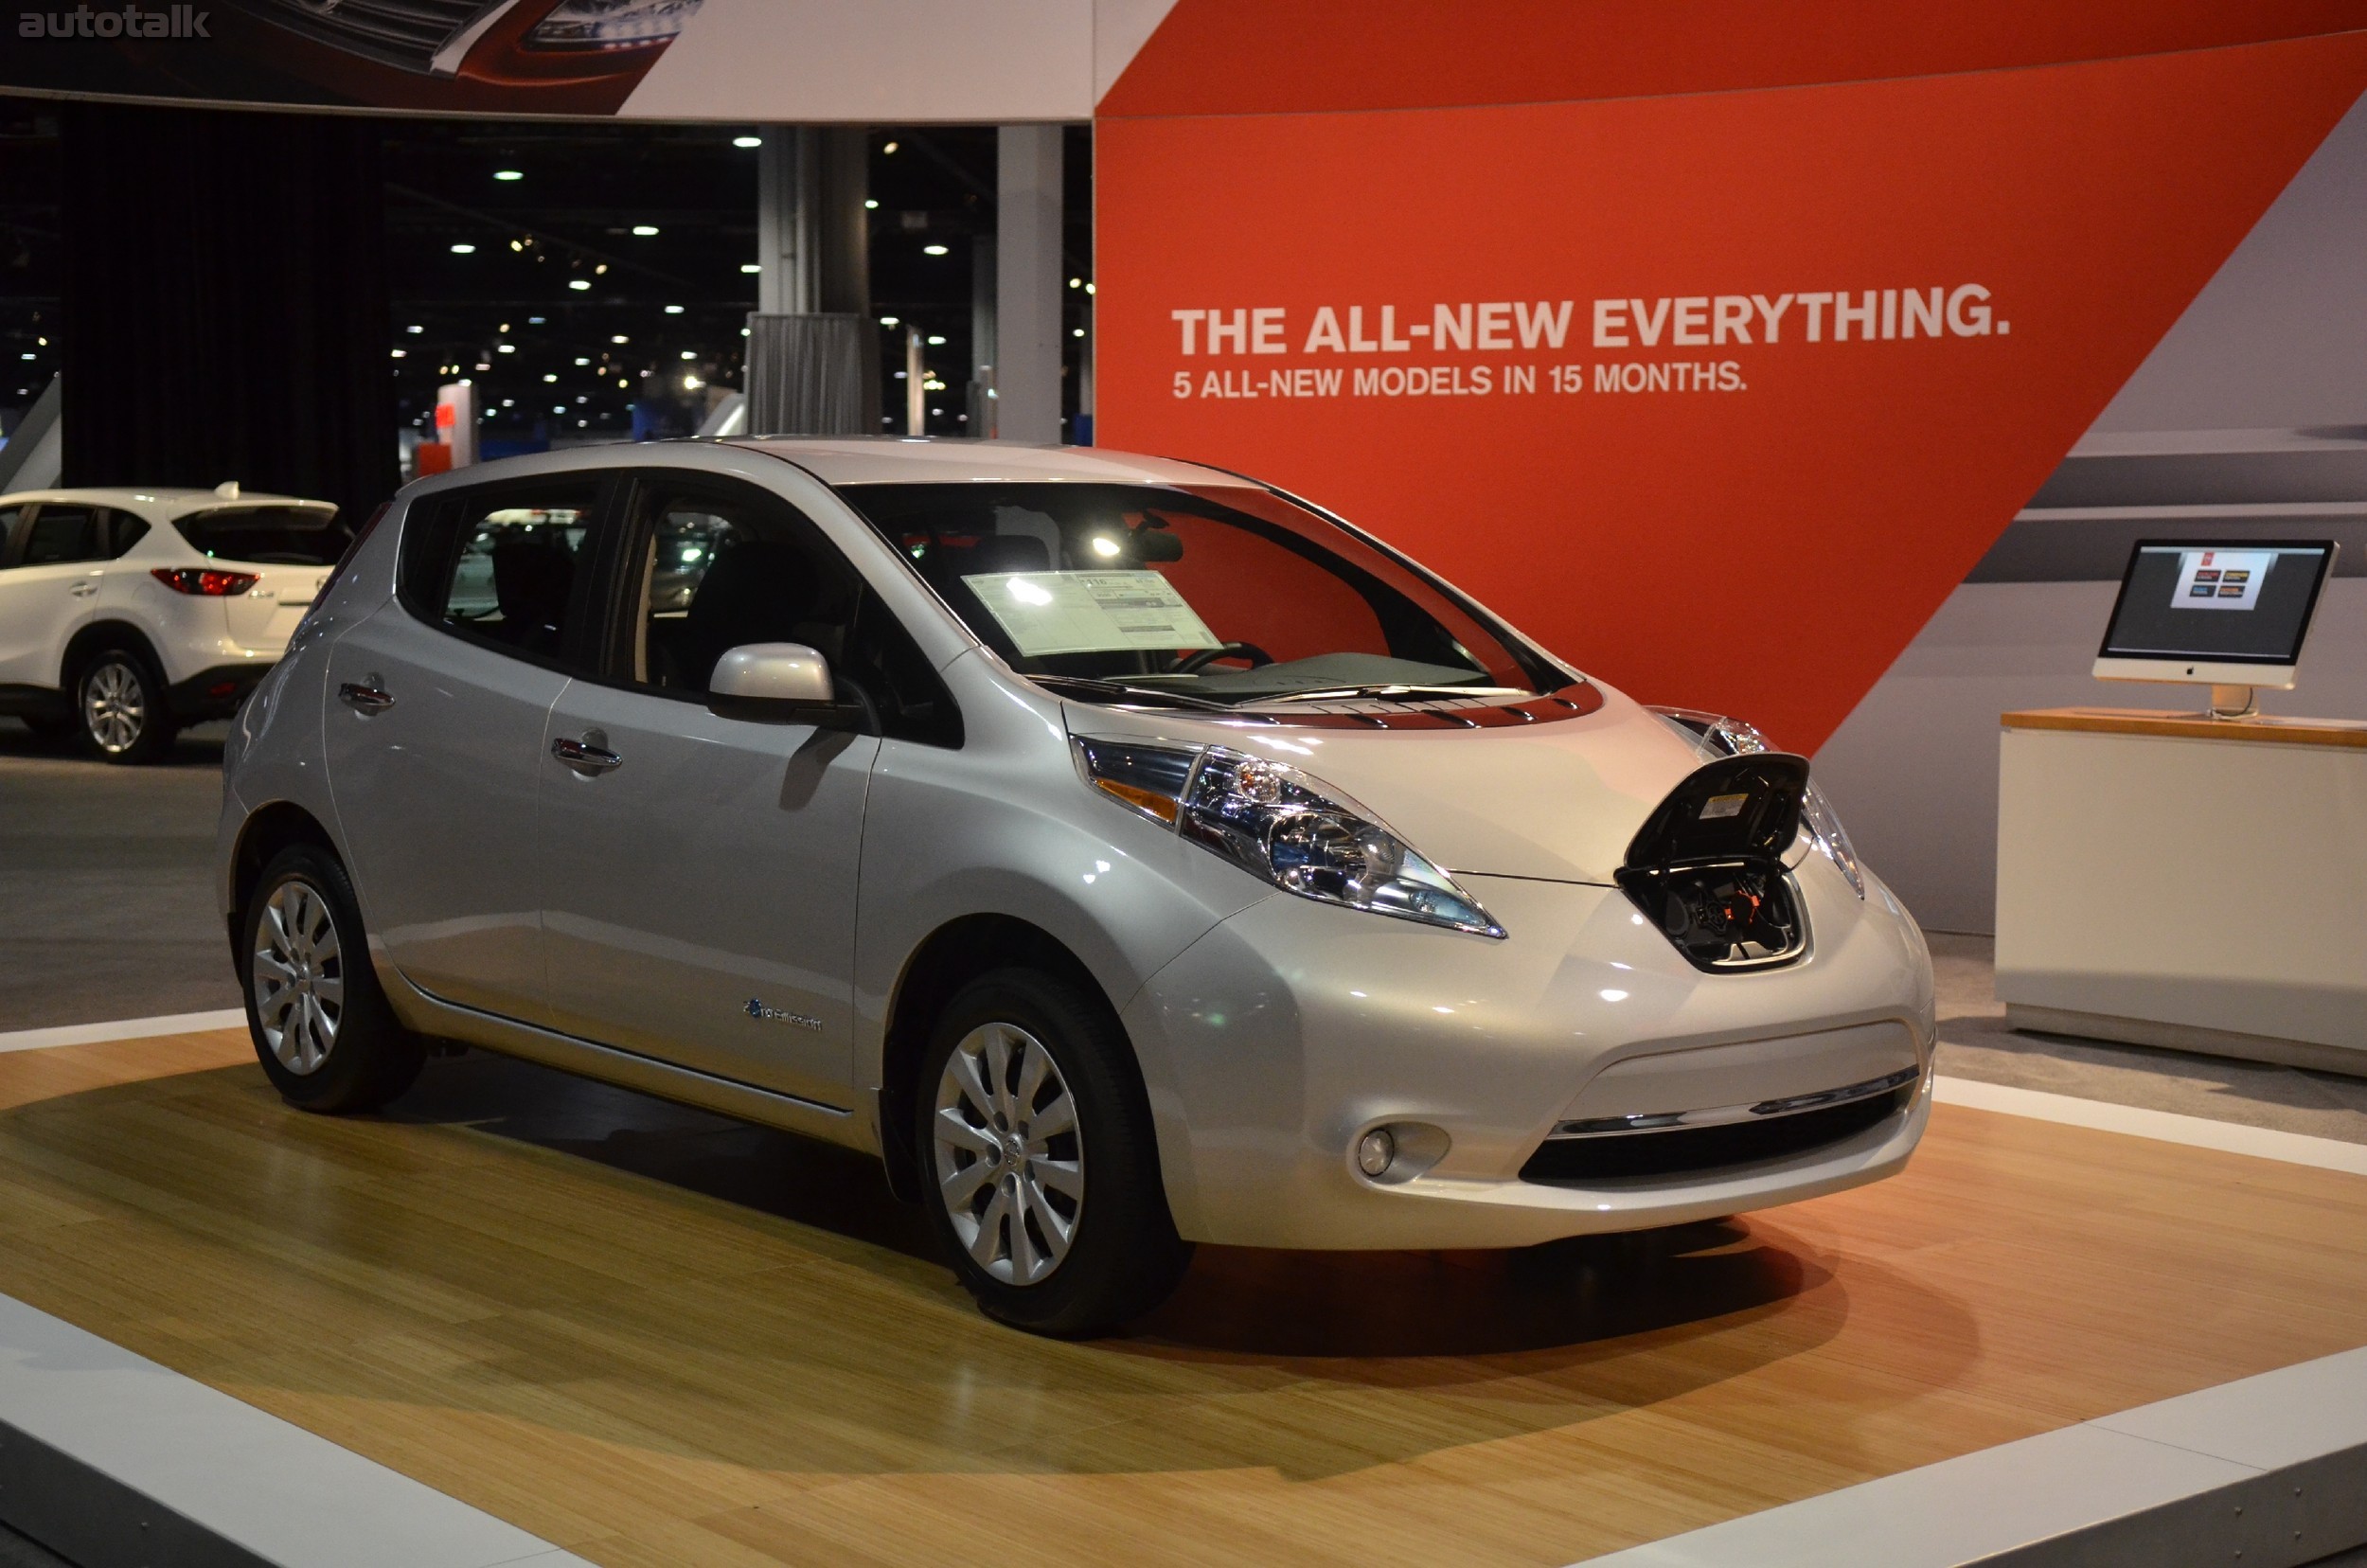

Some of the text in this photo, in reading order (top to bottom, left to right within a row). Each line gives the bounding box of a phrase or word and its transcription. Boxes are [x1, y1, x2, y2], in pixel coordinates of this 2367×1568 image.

[1172, 284, 2009, 355] THE ALL-NEW EVERYTHING.
[1174, 362, 1746, 398] 5 ALL-NEW MODELS IN 15 MONTHS.
